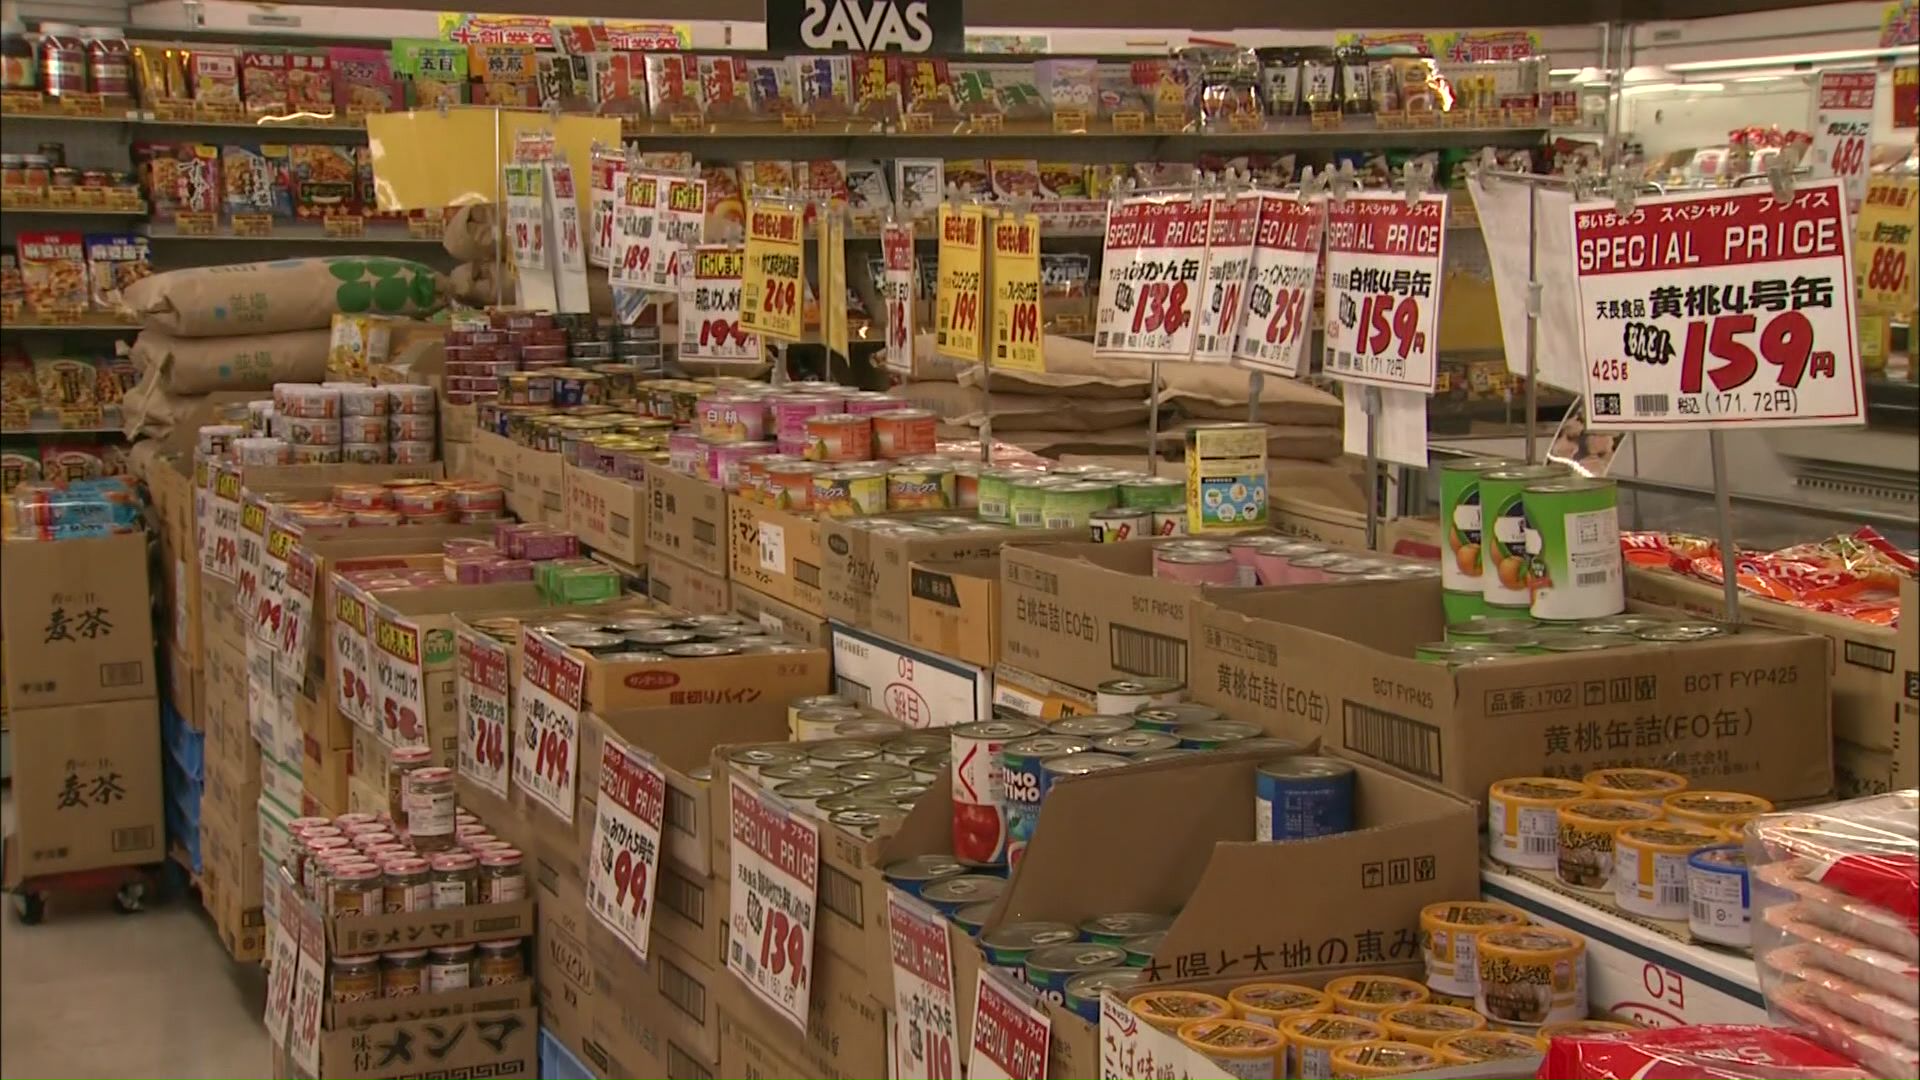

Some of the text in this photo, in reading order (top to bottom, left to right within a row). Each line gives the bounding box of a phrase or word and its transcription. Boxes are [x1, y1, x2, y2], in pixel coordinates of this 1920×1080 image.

[800, 0, 933, 51] SAVAS
[1108, 219, 1207, 247] SPECIAL PRICE
[1660, 202, 1740, 222] スペシャル
[1329, 221, 1439, 254] SPECIAL PRICE
[1579, 231, 1700, 271] SPECIAL
[1724, 218, 1837, 261] PRICE
[1349, 266, 1433, 298] 白桃4号缶
[1869, 246, 1905, 292] 880
[951, 291, 977, 332] 199
[1132, 281, 1188, 336] 138
[1649, 276, 1834, 320] 黄桃4号缶
[1010, 302, 1037, 343] 199
[1356, 294, 1419, 359] 159
[1680, 310, 1836, 394] 159 円
[707, 409, 738, 424] 白桃
[740, 522, 761, 547] マン
[44, 607, 114, 644] 麦茶
[1685, 666, 1798, 694] BCT FYP425
[536, 727, 569, 787] 199
[57, 772, 127, 811] 麦茶
[600, 764, 662, 827] SPECIAL PRICE
[1004, 783, 1040, 802] TIMO
[733, 808, 817, 887] SPECIAL PRICE
[614, 849, 648, 919] 99
[385, 923, 451, 943] メンマ
[760, 906, 806, 989] 139
[351, 1034, 372, 1072] 味付
[377, 1014, 525, 1069] メンマ
[975, 1010, 1008, 1065] SPECIAL
[1105, 1027, 1194, 1080] さば味噌
